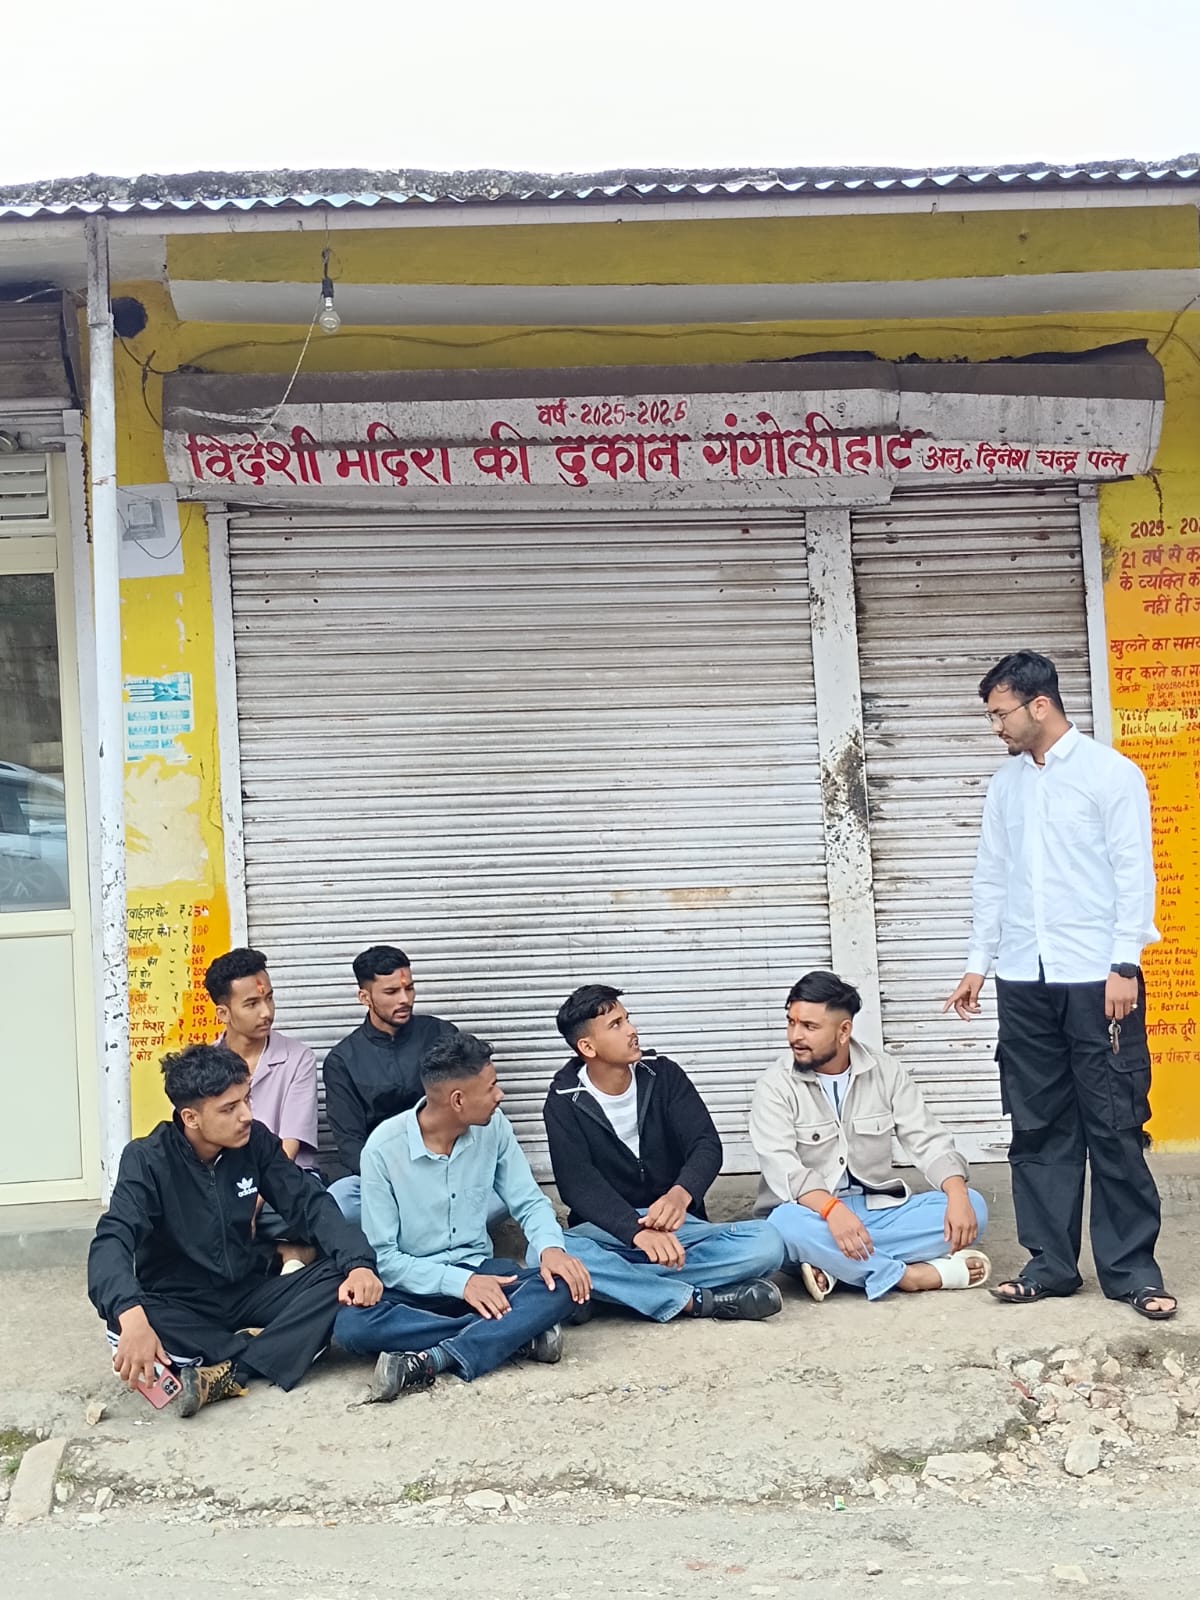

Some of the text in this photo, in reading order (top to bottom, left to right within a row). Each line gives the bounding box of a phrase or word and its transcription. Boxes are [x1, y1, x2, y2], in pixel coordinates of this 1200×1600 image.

[473, 421, 532, 484] की
[551, 433, 692, 488] दुकान
[976, 442, 1031, 474] दिनेश
[1087, 450, 1130, 474] पन्त
[1121, 551, 1136, 568] 21
[1142, 544, 1164, 566] वर्ष
[1168, 544, 1184, 563] से
[1119, 571, 1133, 591] के
[1138, 566, 1186, 591] व्यक्ति
[1142, 594, 1171, 615] नहीं
[1174, 592, 1192, 615] दी
[1152, 638, 1171, 651] का
[1171, 665, 1188, 678] का
[1144, 967, 1170, 978] mazing
[1146, 1018, 1178, 1036] माजिक
